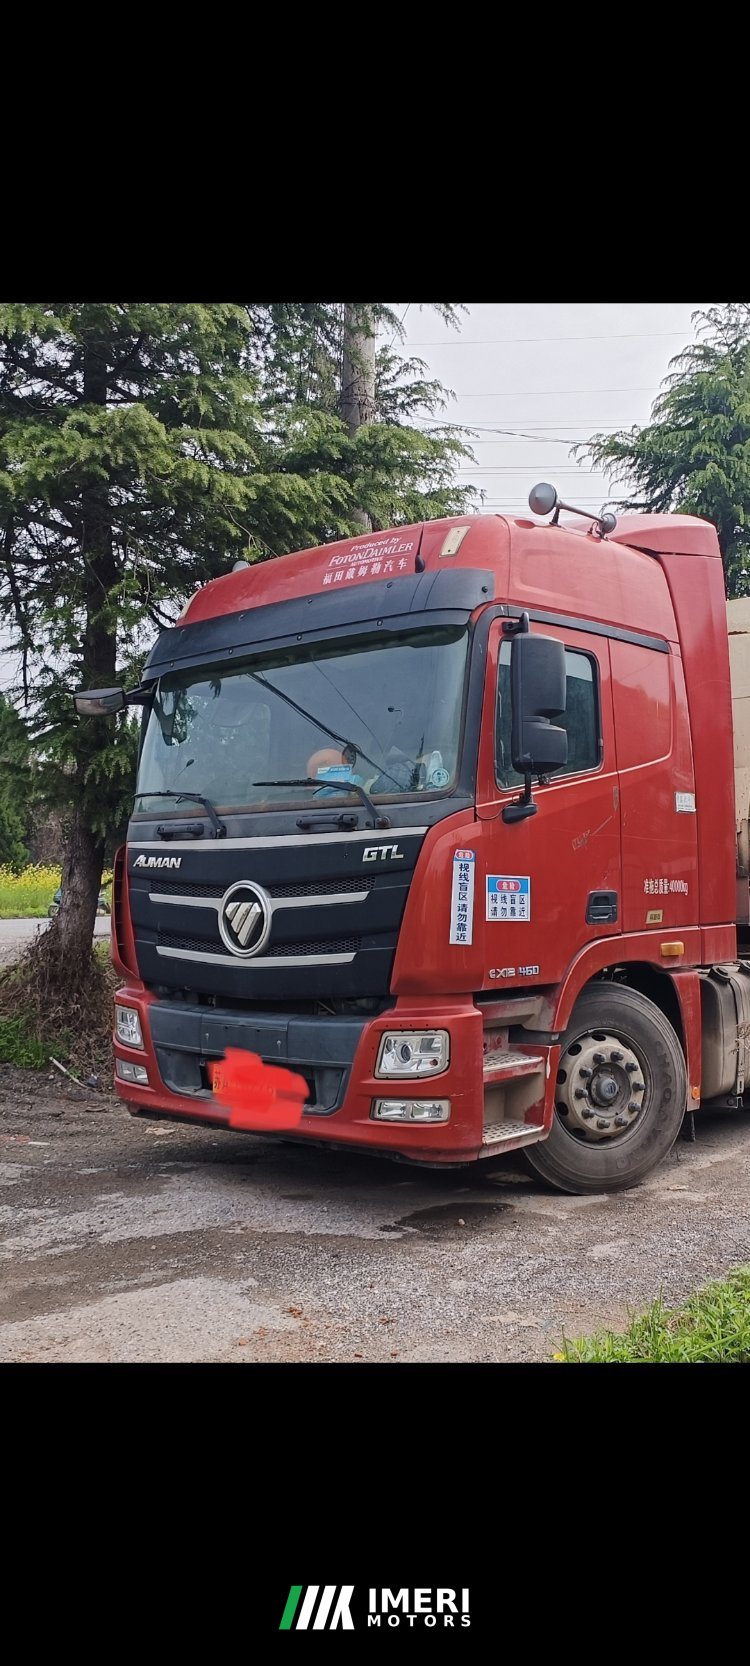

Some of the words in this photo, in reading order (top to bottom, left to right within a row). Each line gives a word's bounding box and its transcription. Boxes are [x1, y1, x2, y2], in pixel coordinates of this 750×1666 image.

[350, 538, 389, 552] Produced
[389, 537, 401, 545] by
[322, 557, 408, 585] 福田戴姆勒汽车
[362, 844, 404, 862] GTL
[132, 854, 182, 869] AUMAN
[490, 893, 526, 905] 视线盲区
[490, 906, 526, 917] 请勿靠近
[518, 965, 540, 976] 460
